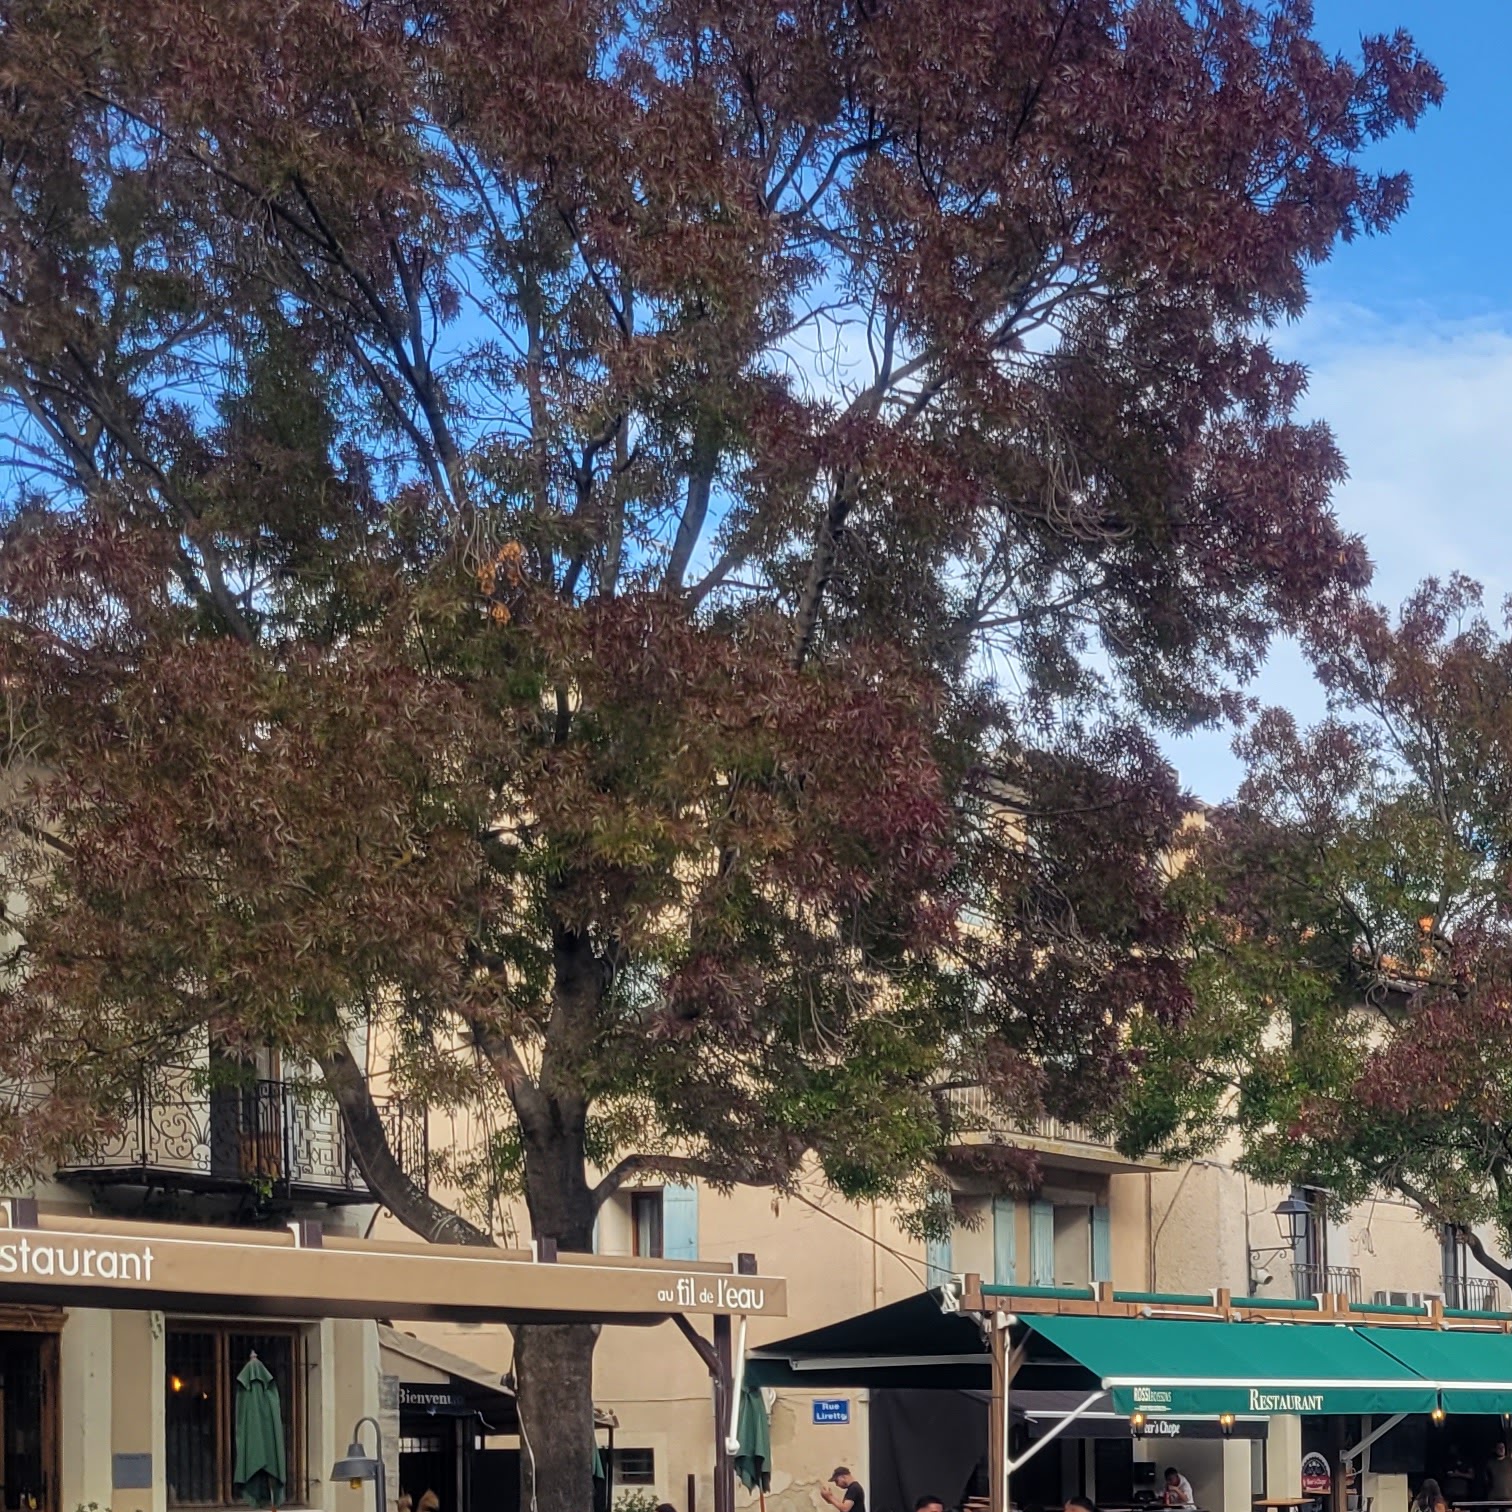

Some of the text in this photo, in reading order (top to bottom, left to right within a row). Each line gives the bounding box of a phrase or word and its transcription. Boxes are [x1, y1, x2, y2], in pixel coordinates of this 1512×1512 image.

[0, 1238, 154, 1281] staurant
[658, 1277, 764, 1309] au fil de l'eau
[399, 1388, 464, 1405] Bienvenu
[822, 1403, 840, 1411] Rue
